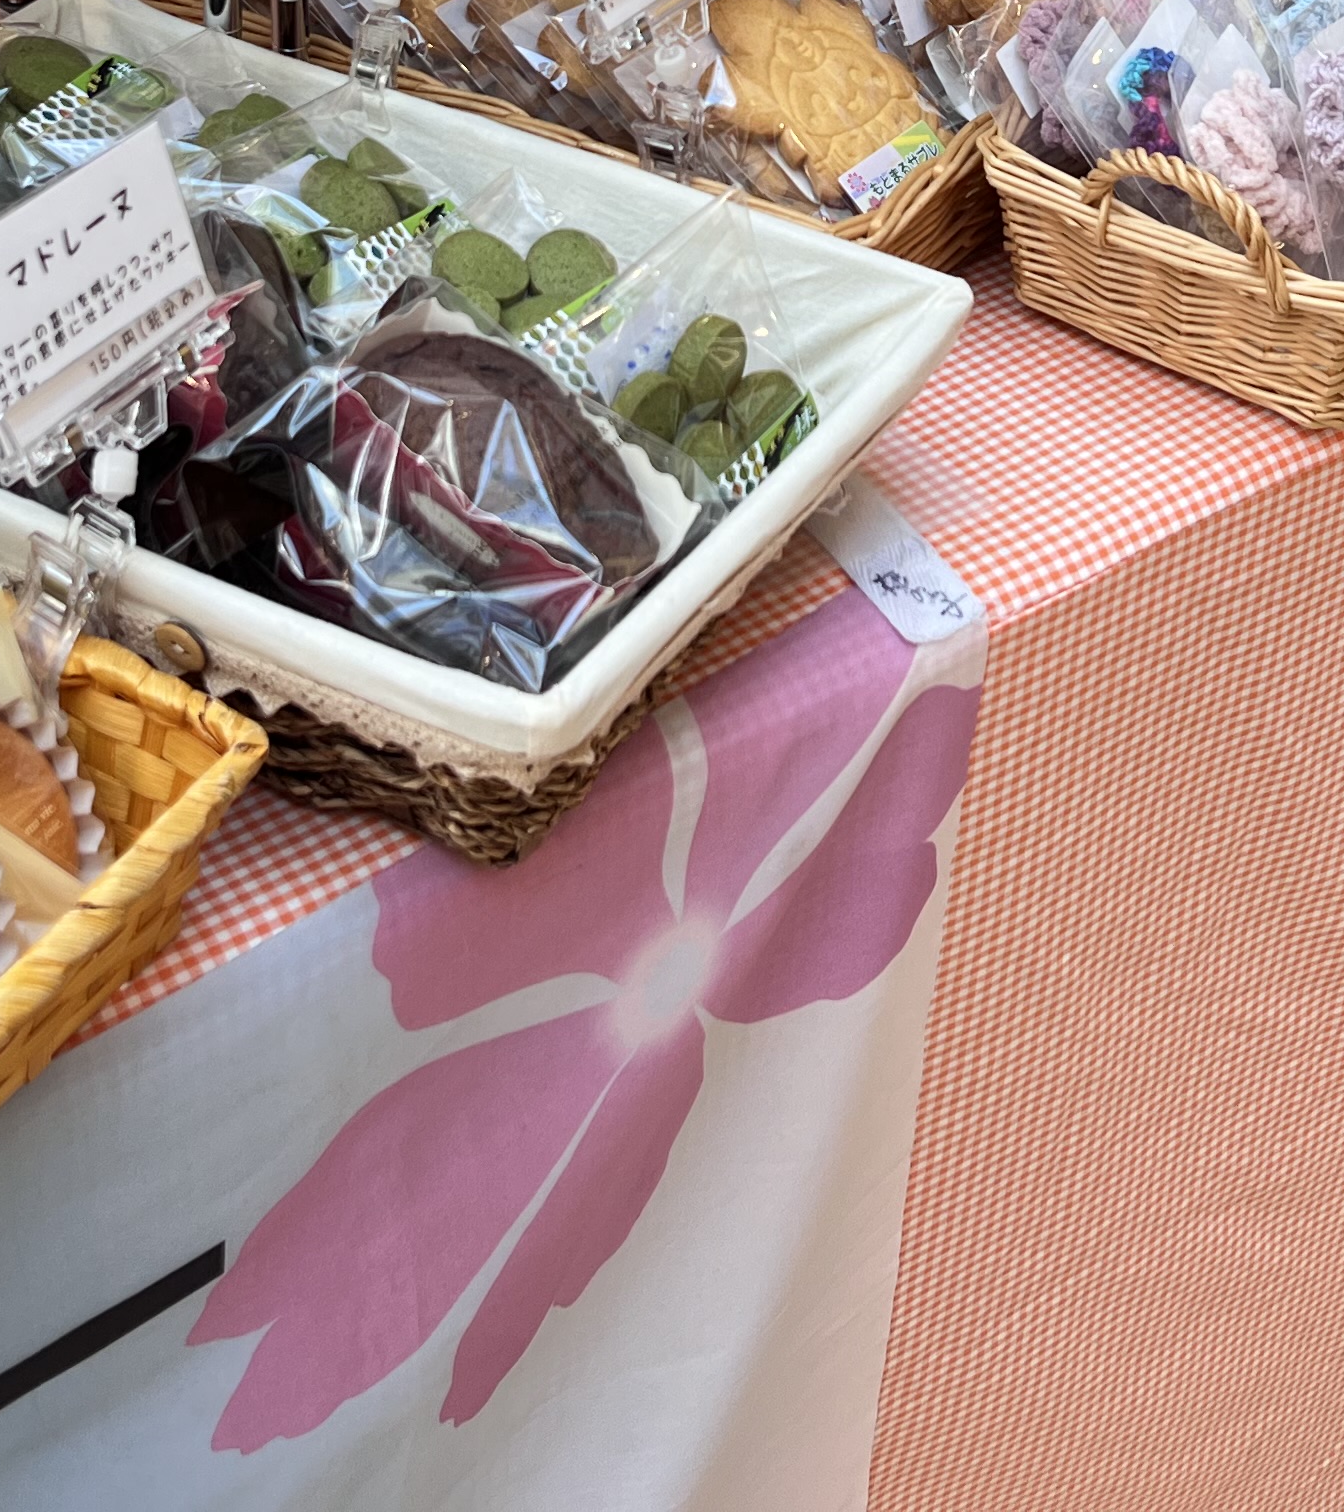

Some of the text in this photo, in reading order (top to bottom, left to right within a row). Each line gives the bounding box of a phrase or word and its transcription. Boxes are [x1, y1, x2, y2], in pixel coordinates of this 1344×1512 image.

[7, 186, 134, 289] マドレーヌ
[88, 276, 205, 378] 150円(税込み)
